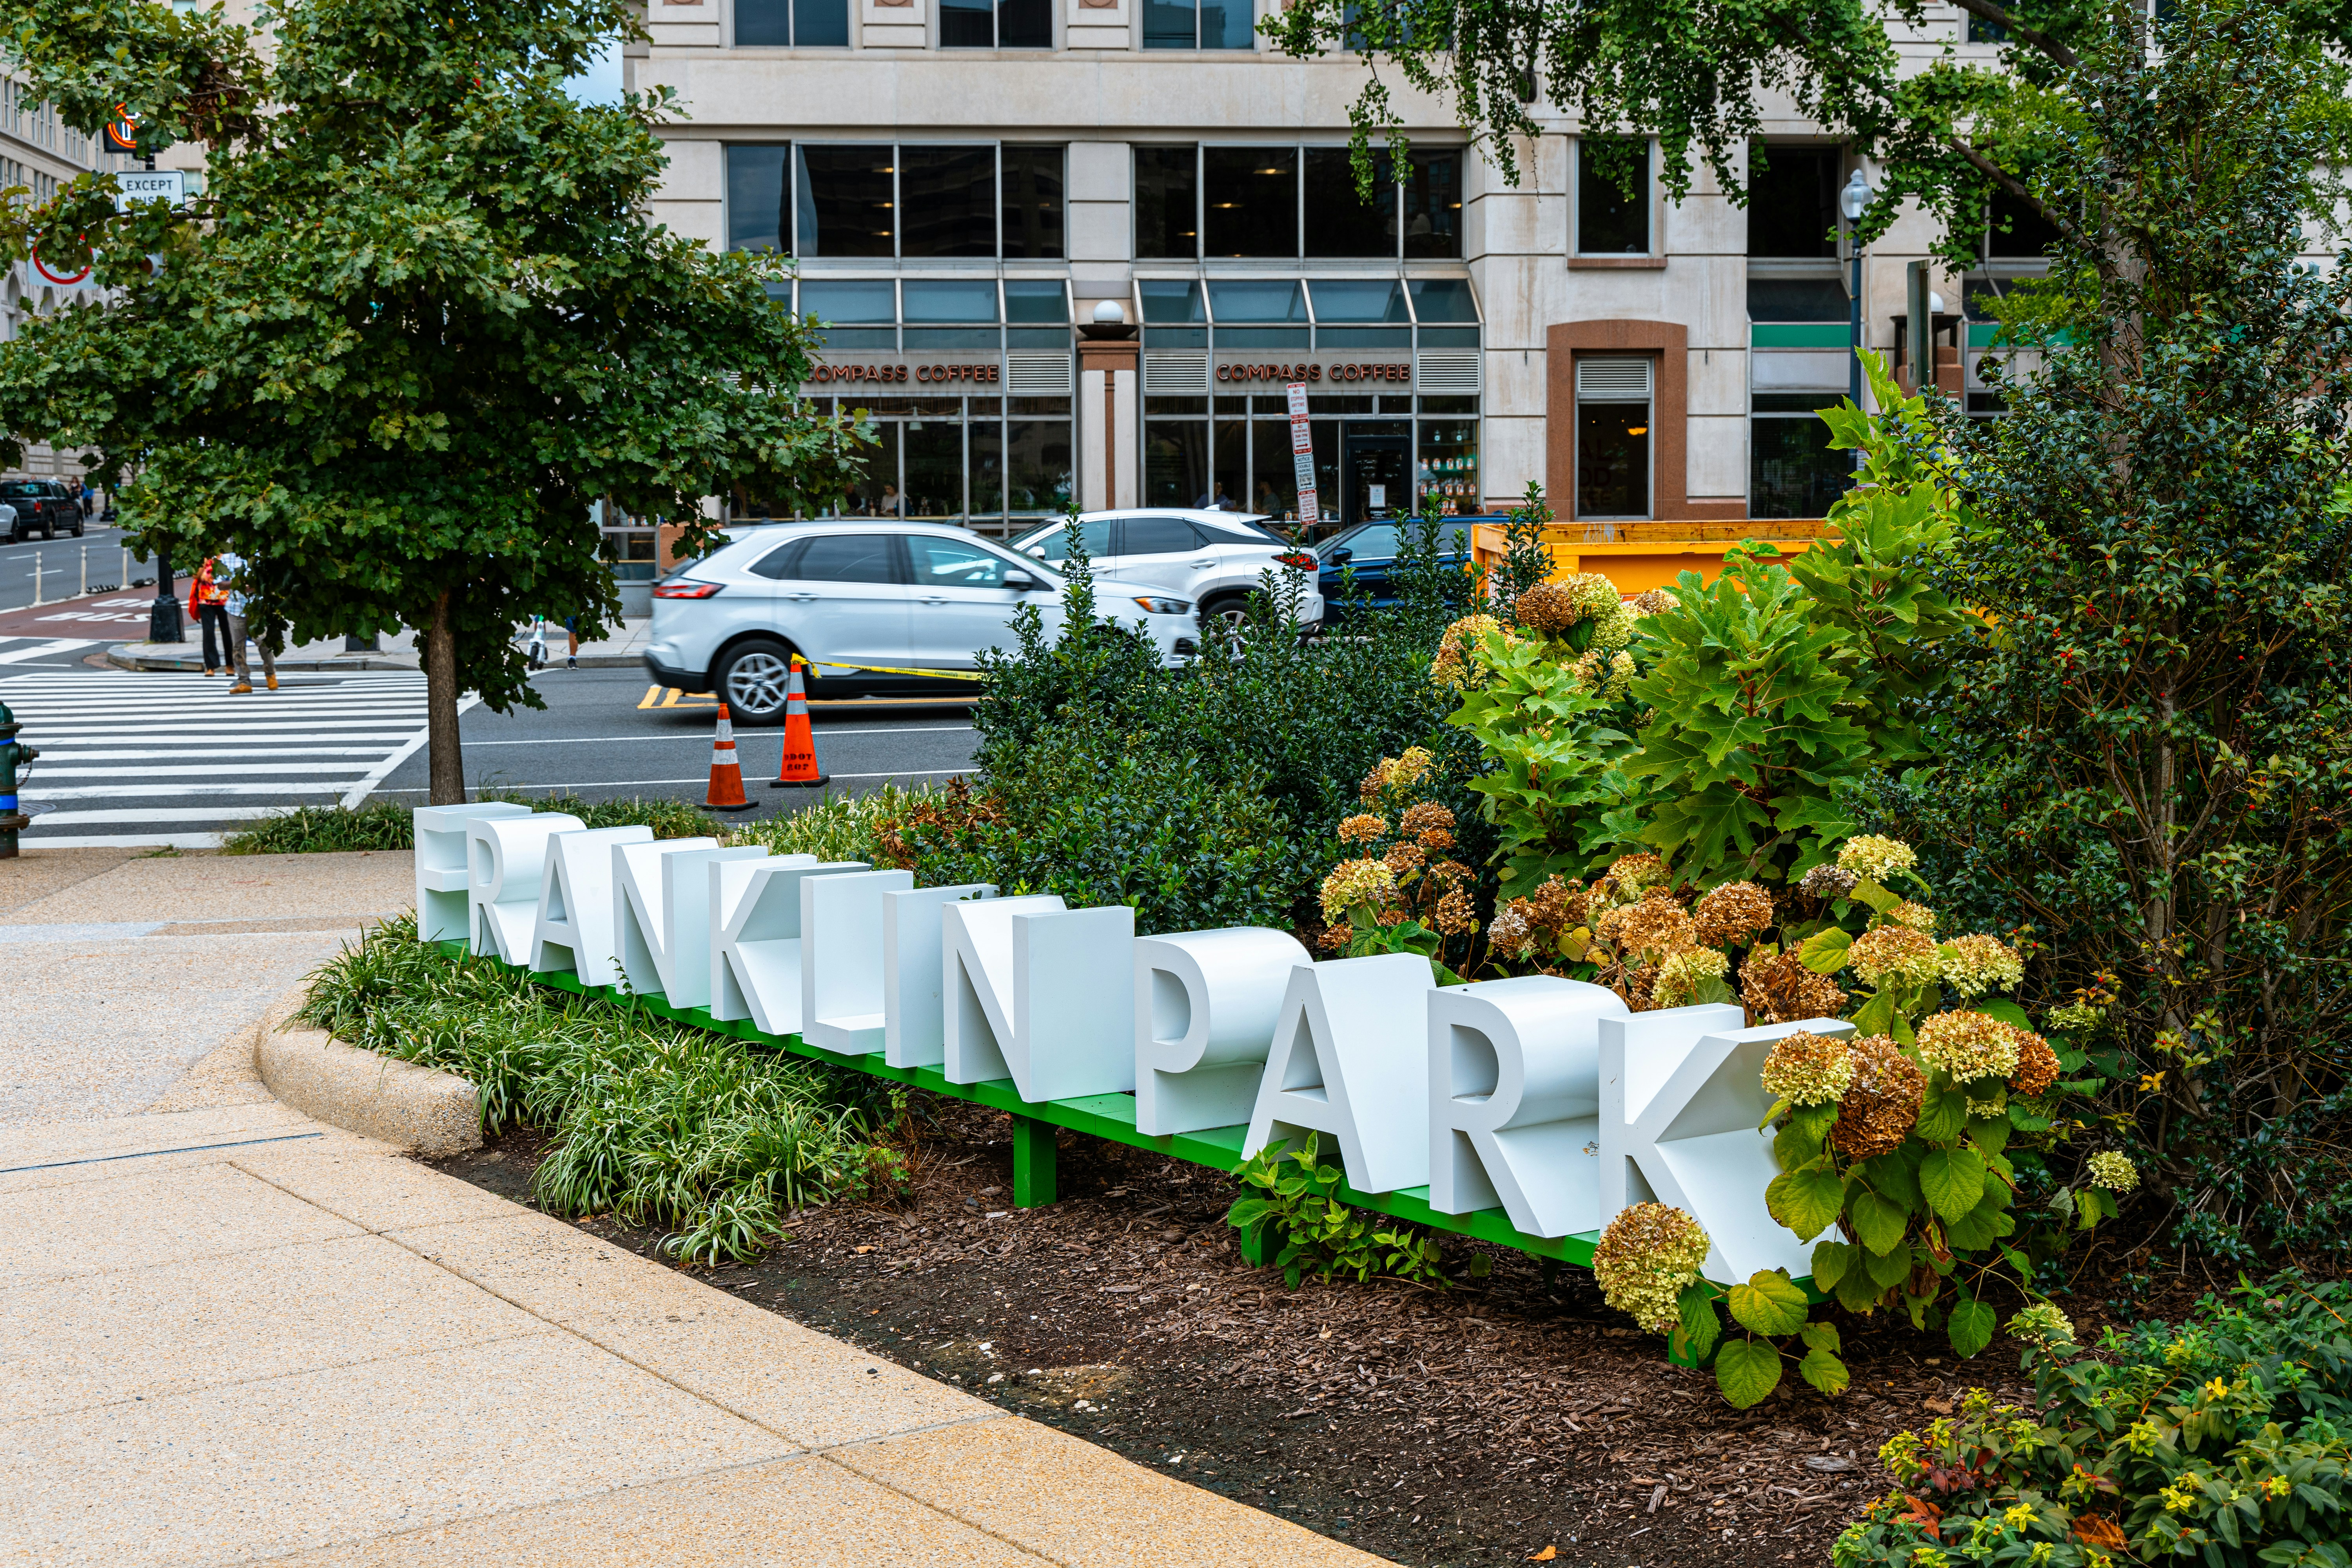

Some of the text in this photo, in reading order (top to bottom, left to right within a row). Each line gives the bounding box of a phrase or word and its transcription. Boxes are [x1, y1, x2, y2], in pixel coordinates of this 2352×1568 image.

[127, 180, 173, 191] EXCEPT
[916, 365, 999, 382] COFFEE
[1216, 364, 1410, 381] COMPASS COFFEE
[34, 612, 152, 622] BUS
[414, 802, 1856, 1286] FRANKLIN PARK
